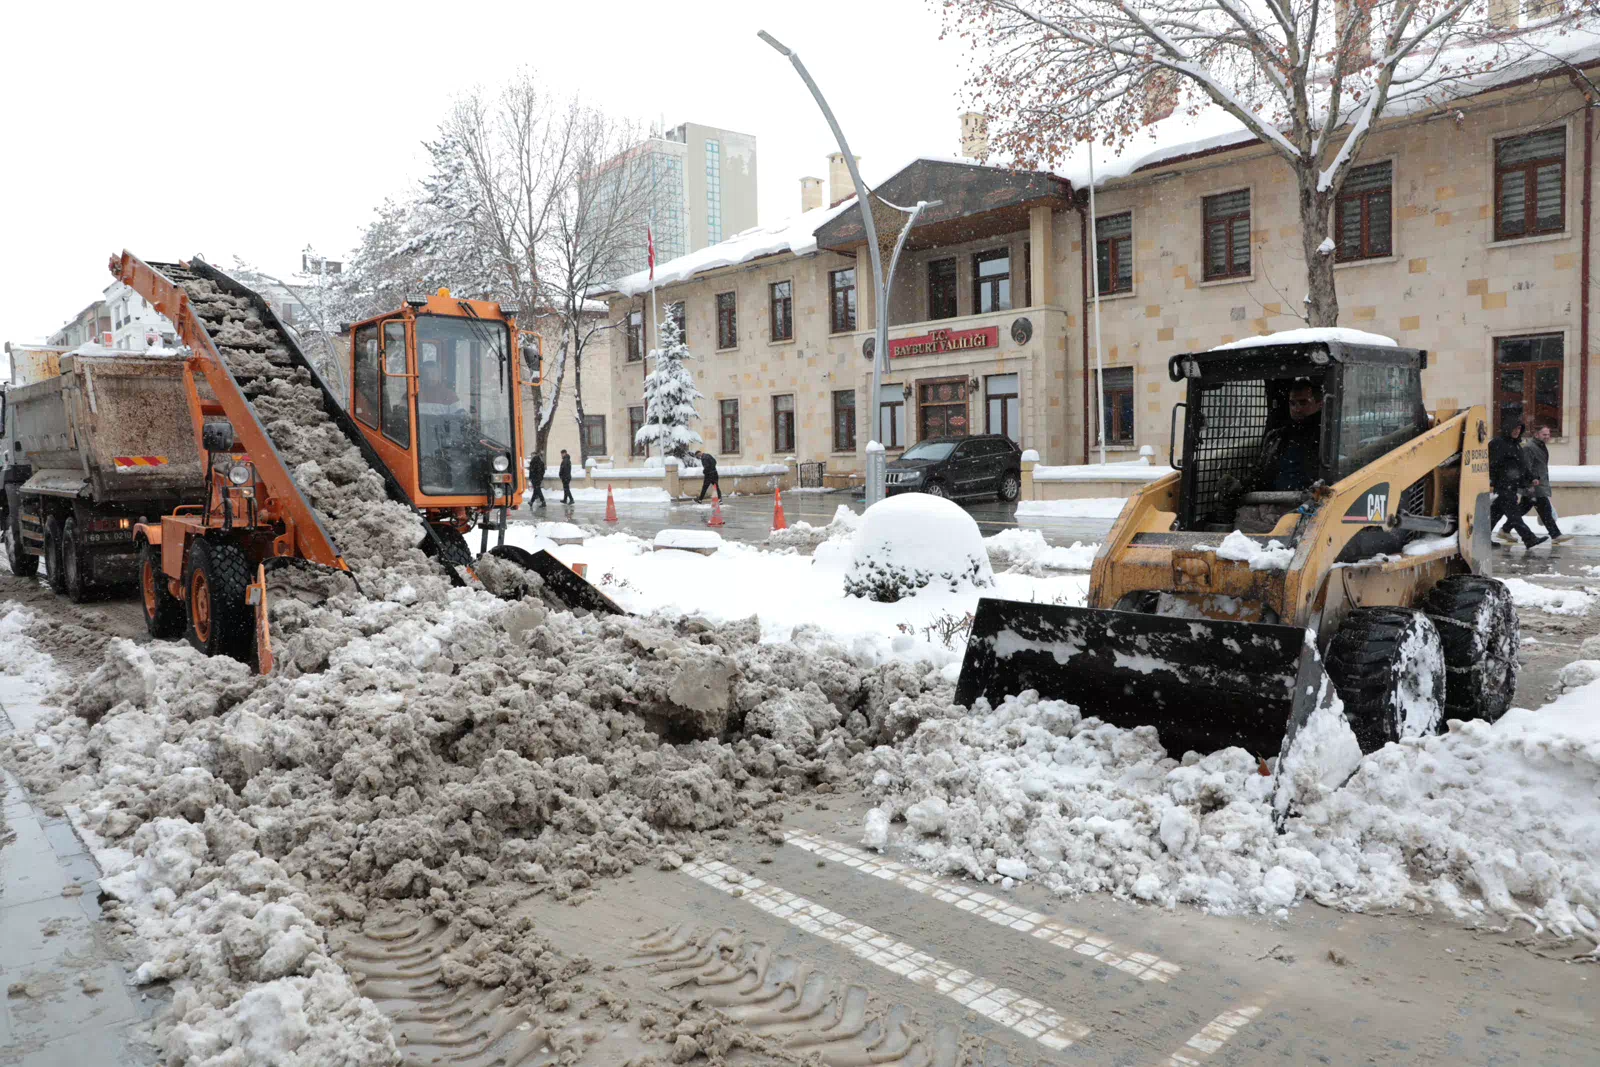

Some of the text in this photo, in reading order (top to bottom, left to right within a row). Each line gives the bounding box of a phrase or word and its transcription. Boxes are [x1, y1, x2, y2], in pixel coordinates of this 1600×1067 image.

[930, 330, 948, 341] T.C.
[894, 342, 939, 356] BAYBURT
[1367, 493, 1387, 521] CAT
